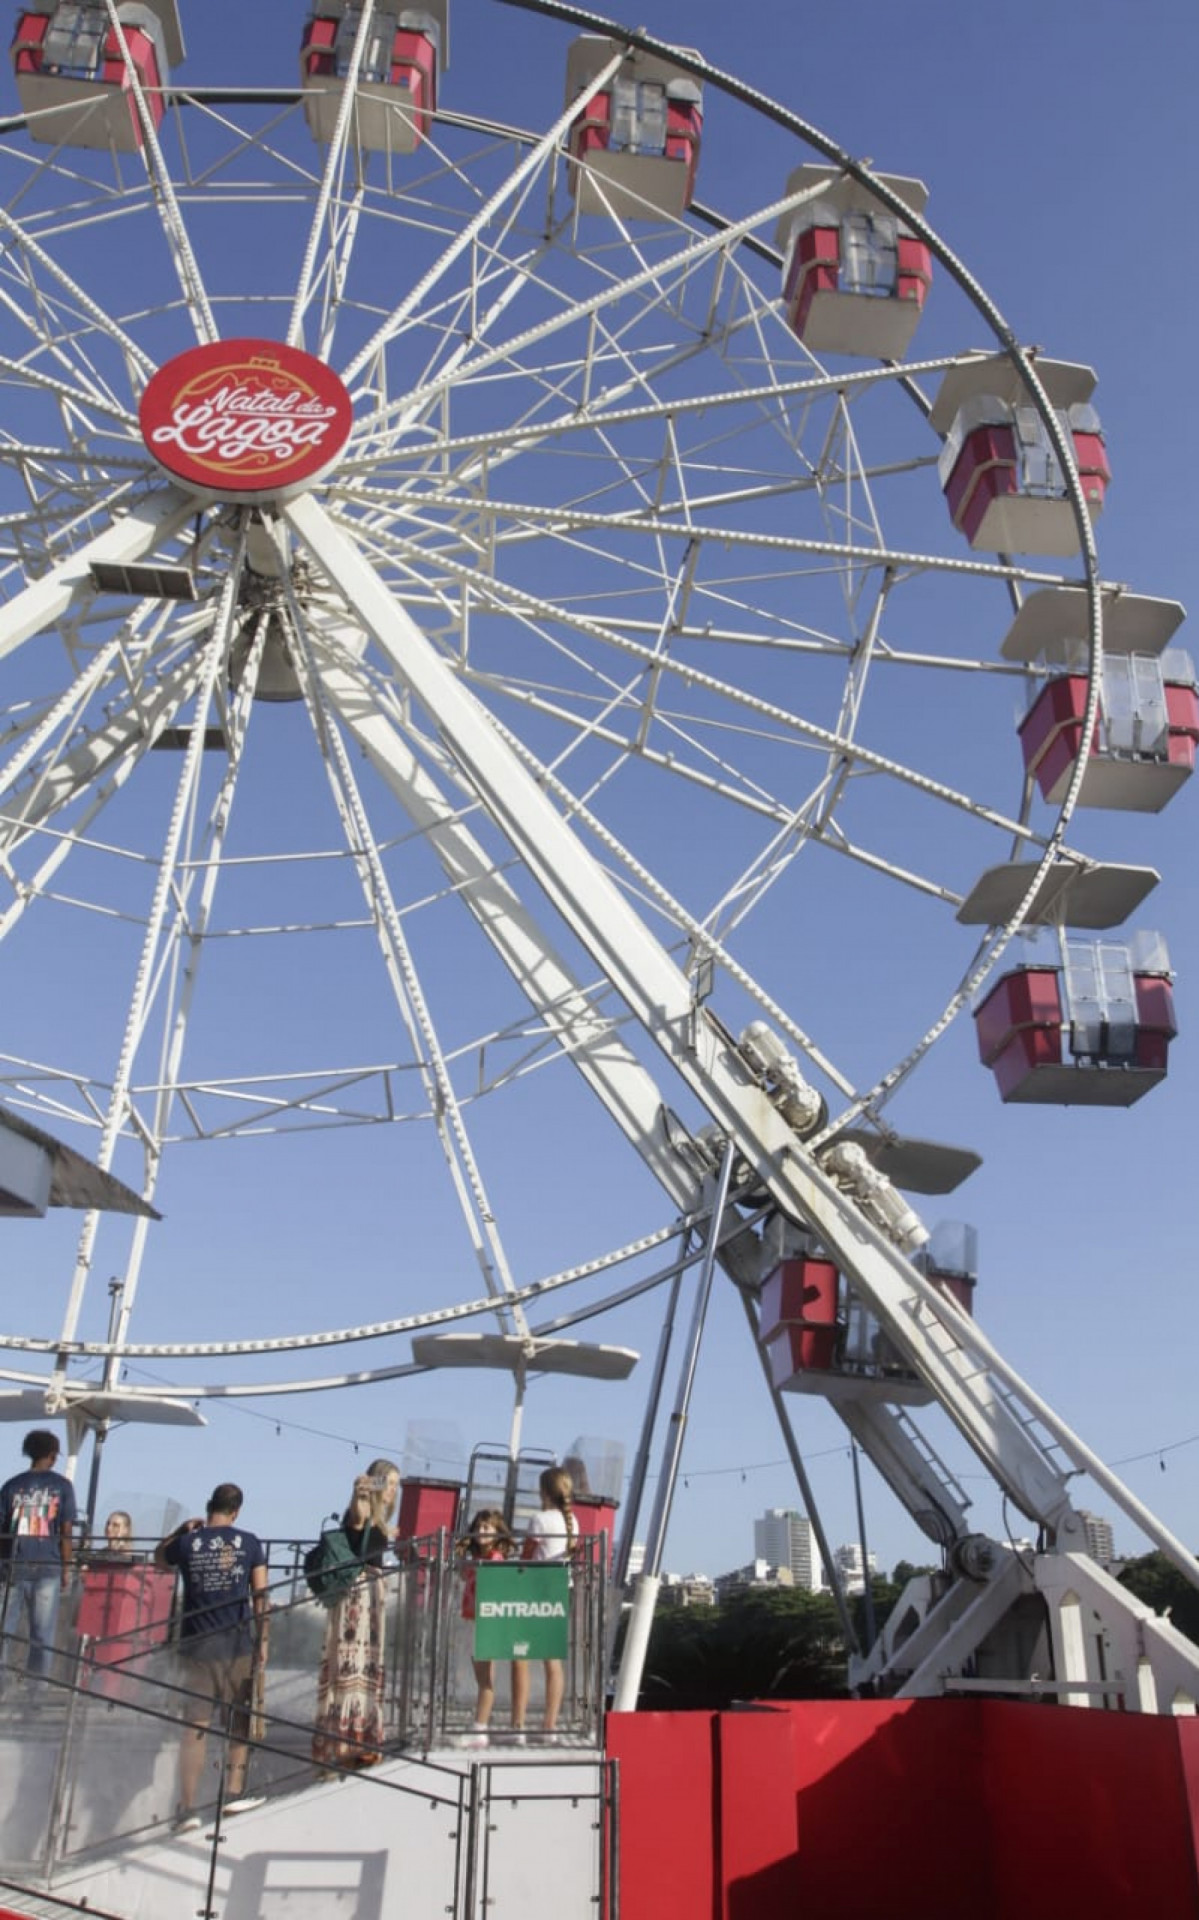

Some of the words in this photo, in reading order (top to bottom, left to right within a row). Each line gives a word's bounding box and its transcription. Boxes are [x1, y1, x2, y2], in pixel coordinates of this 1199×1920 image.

[205, 386, 300, 412] Natal
[296, 396, 324, 413] da
[152, 403, 330, 459] Lagoa
[480, 1602, 565, 1617] ENTRADA
